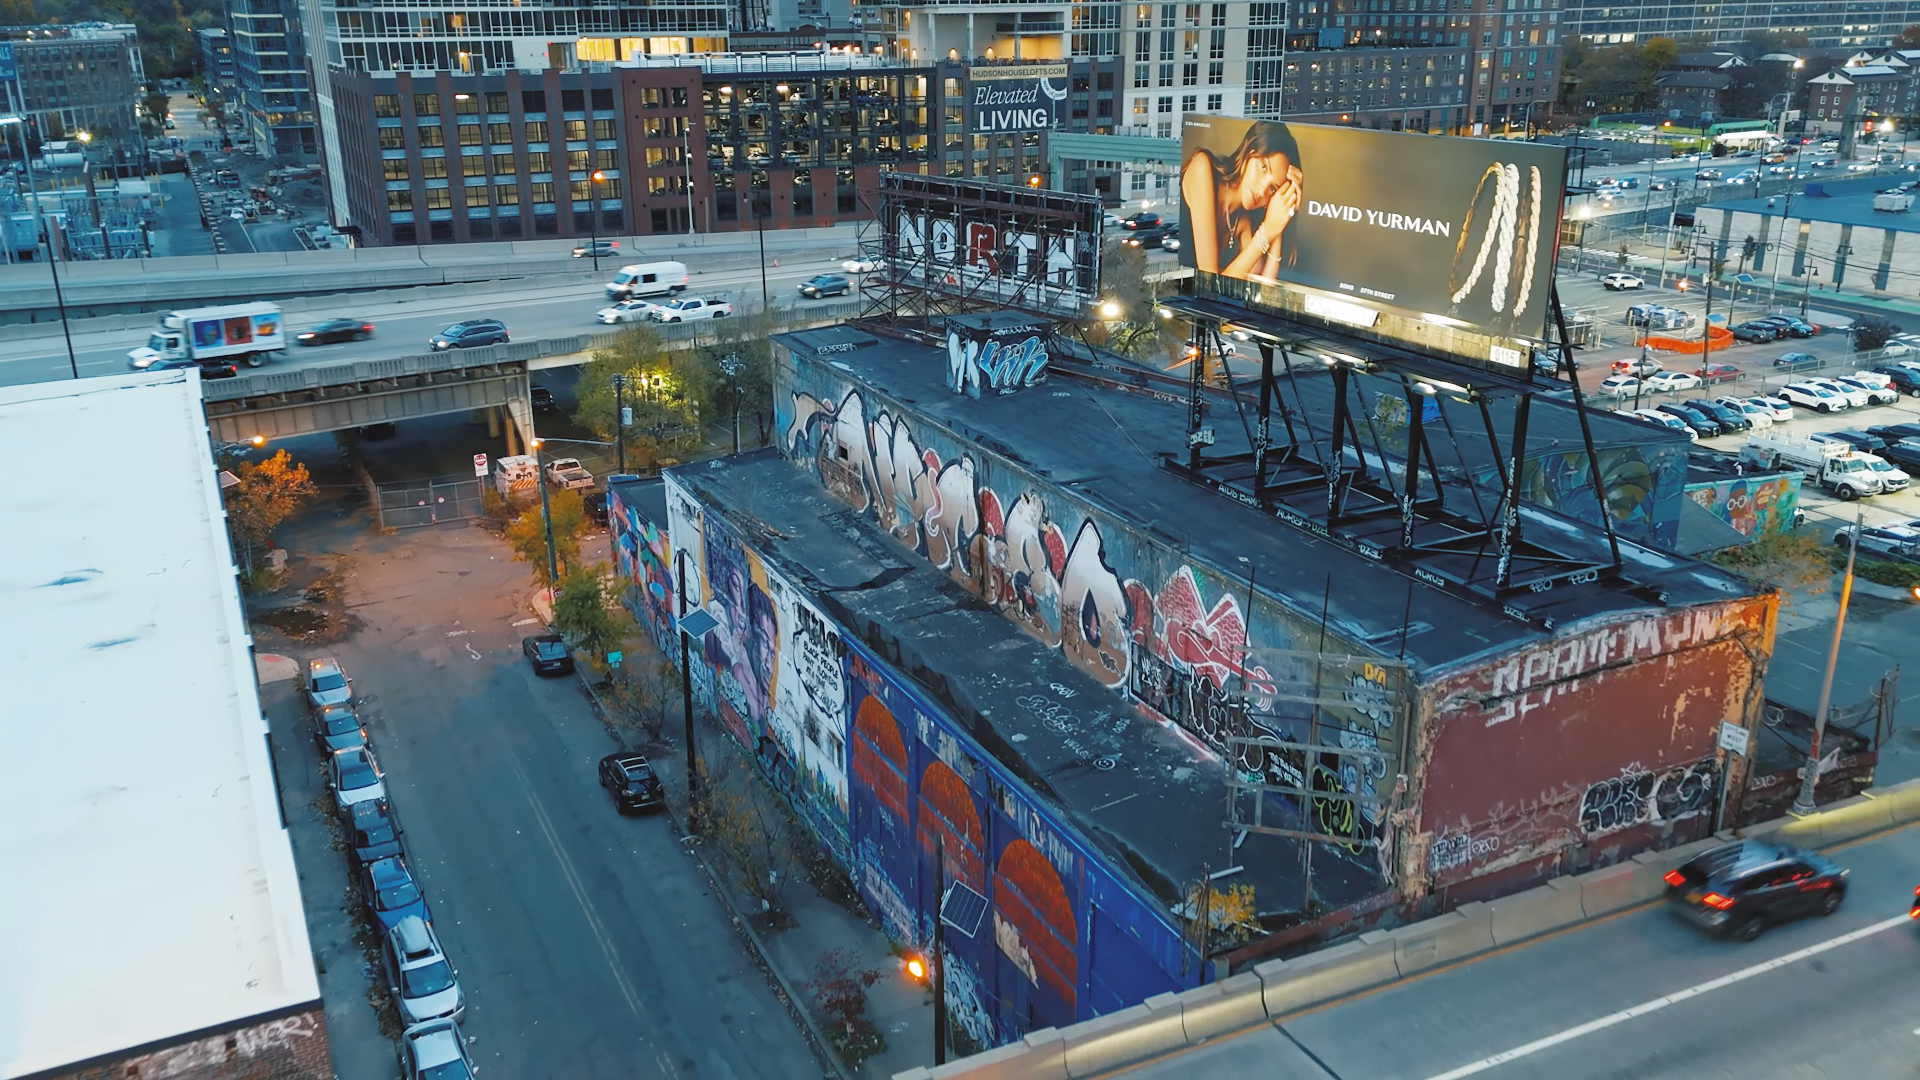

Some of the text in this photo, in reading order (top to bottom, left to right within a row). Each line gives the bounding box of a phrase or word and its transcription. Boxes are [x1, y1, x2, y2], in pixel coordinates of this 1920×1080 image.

[972, 67, 1066, 78] HUDSONHOUSELOFTS.COM
[973, 83, 1039, 106] Elevated
[980, 108, 1048, 131] LIVING
[1308, 200, 1451, 238] DAVID YURMAN
[1339, 282, 1396, 301] SOHO 57TH STREET
[1495, 350, 1515, 366] 0115
[803, 640, 839, 680] BLACK PEOPLE
